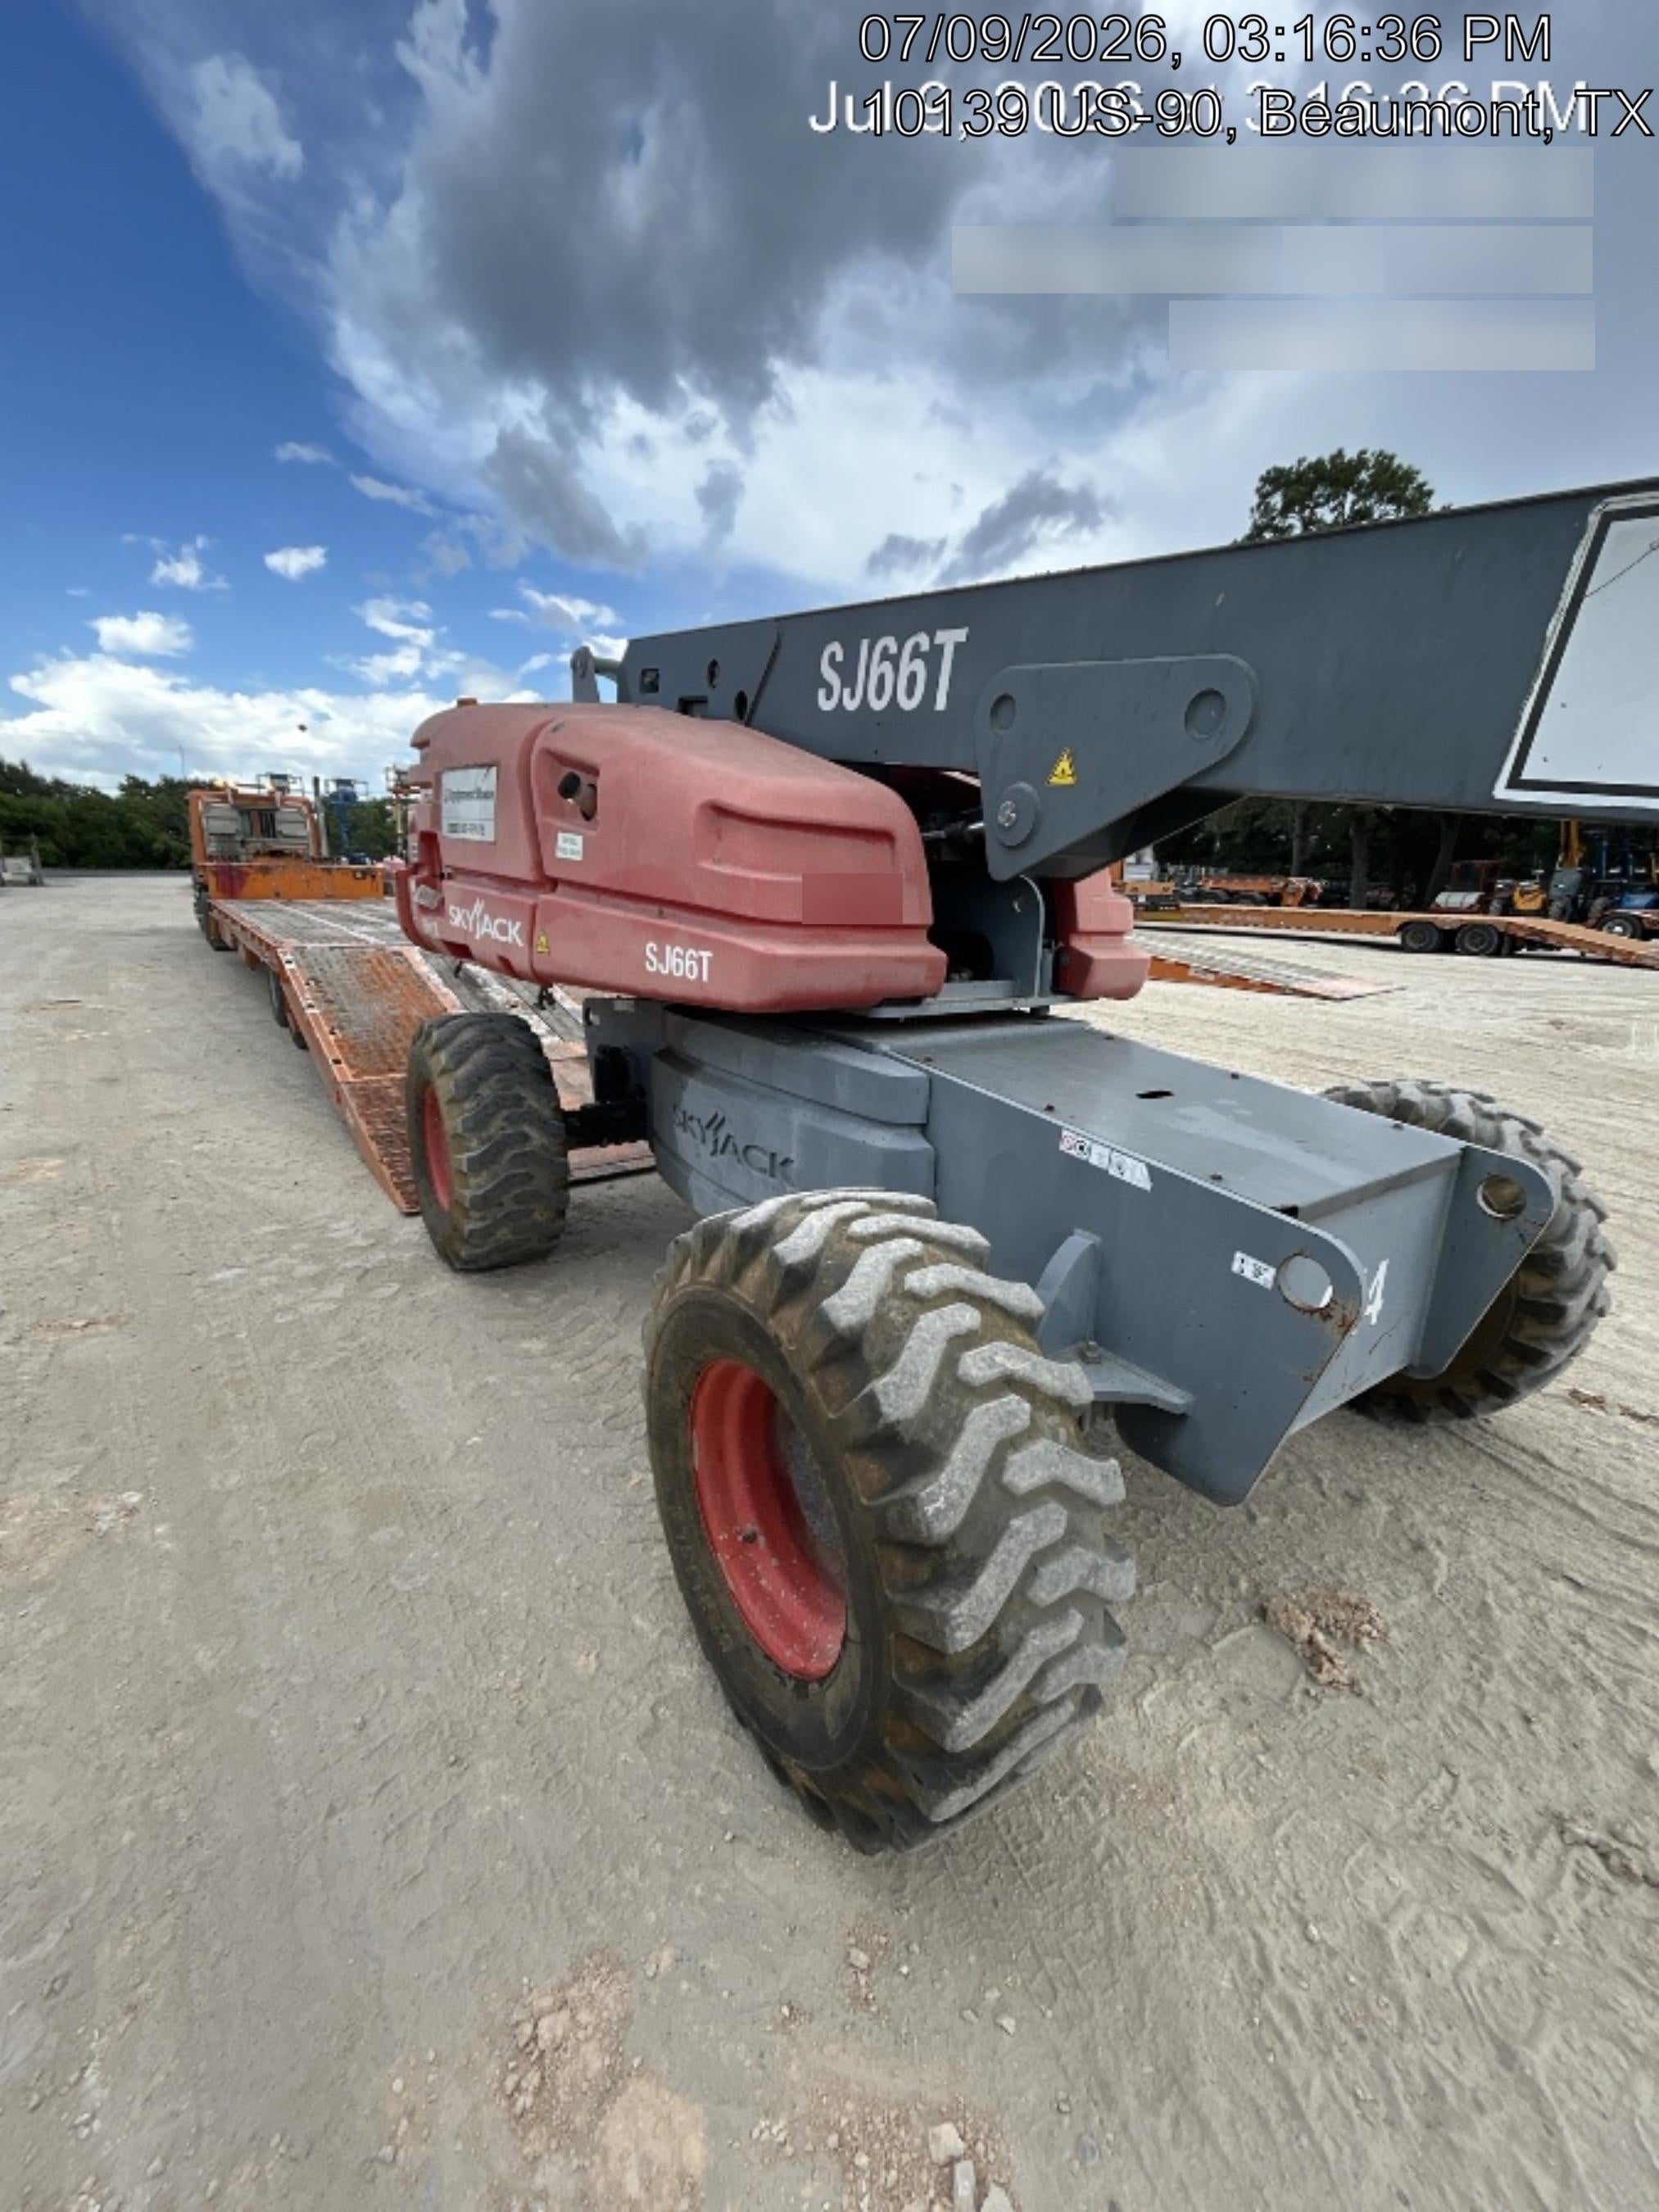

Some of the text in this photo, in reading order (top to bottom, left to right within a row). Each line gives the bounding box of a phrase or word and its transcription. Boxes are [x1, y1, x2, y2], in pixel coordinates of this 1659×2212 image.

[818, 626, 969, 711] SJ66T
[449, 896, 524, 946] SKYJACK
[645, 941, 714, 982] SJ66T
